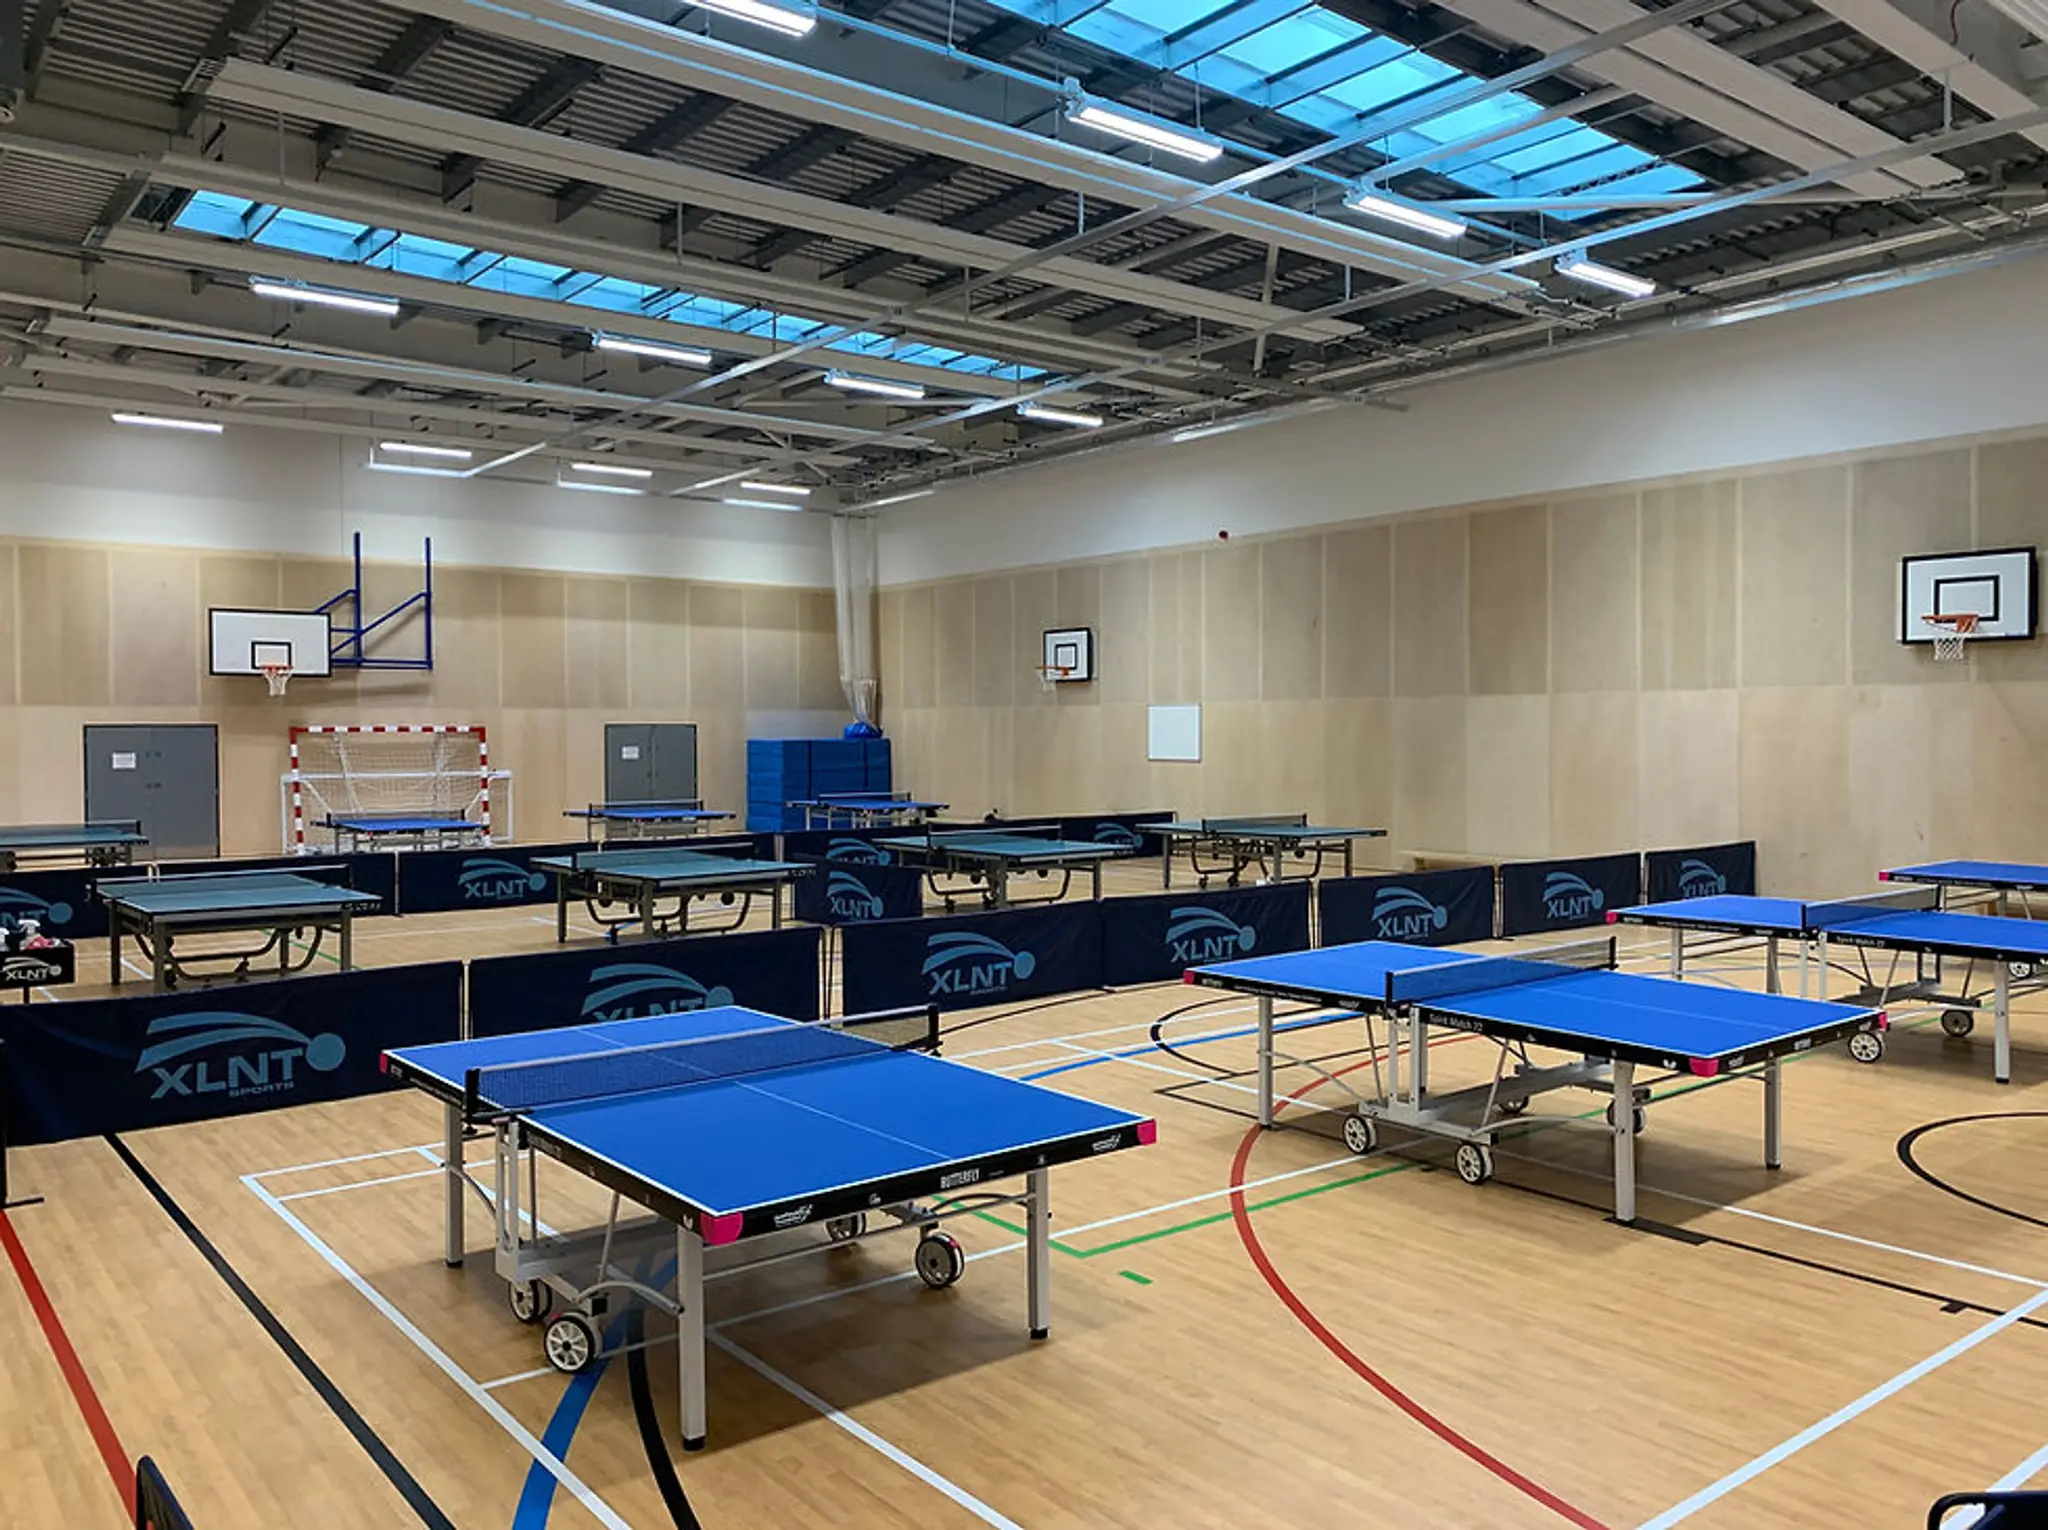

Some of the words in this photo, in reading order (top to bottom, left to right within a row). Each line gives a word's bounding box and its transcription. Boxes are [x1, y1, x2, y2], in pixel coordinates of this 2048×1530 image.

[464, 878, 527, 899] XLNT
[830, 896, 872, 919] XLNT
[1546, 896, 1592, 919] XLNT
[1377, 913, 1433, 938] XLNT
[1170, 934, 1238, 963] XLNT
[5, 968, 50, 982] XLNT
[929, 961, 1013, 995] XLNT
[150, 1047, 304, 1100] XLNT
[228, 1080, 295, 1098] SPORTS
[940, 1166, 981, 1190] BUTTERFLY
